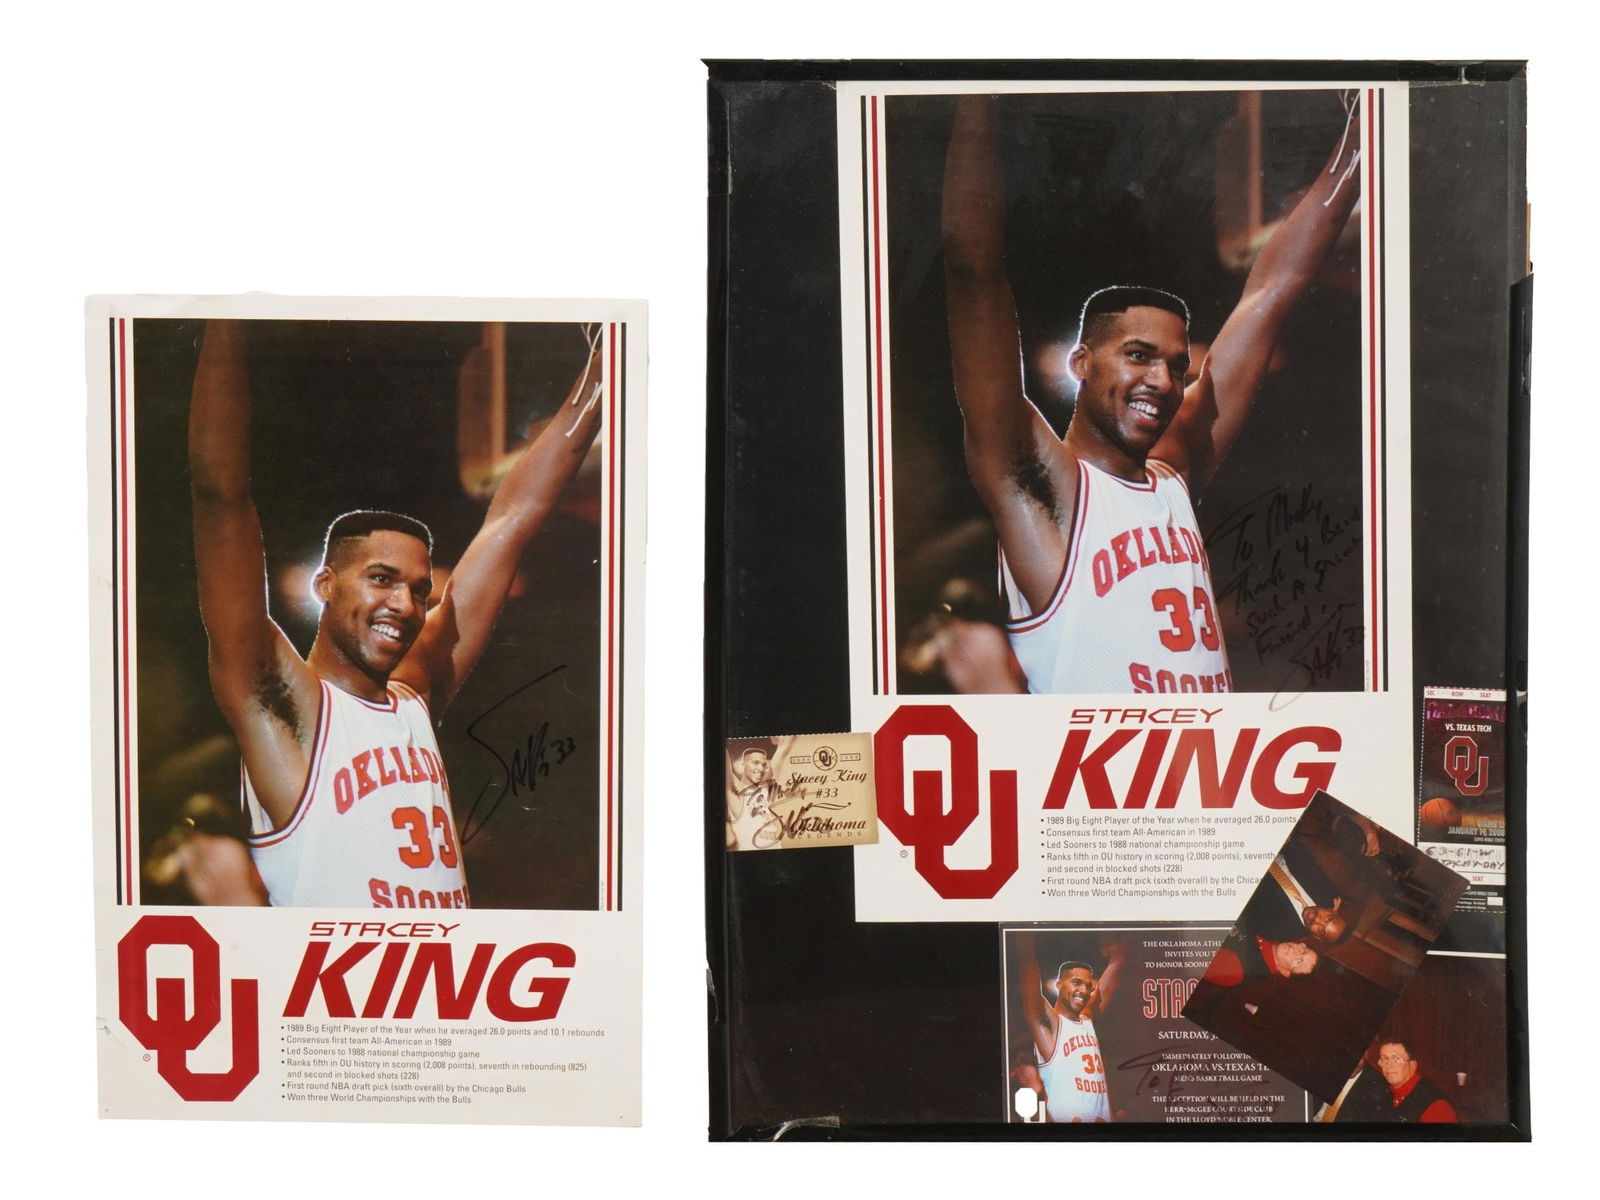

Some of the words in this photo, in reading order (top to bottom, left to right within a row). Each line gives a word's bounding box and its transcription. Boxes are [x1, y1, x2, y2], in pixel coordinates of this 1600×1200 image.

[1151, 586, 1220, 652] 33
[1069, 708, 1223, 724] STACEY
[1456, 724, 1475, 732] TEXAS
[819, 750, 832, 766] OU
[1042, 726, 1342, 810] KING
[1444, 736, 1490, 796] OU
[786, 771, 828, 786] Stacey
[832, 769, 867, 783] King
[816, 787, 839, 798] #33
[874, 705, 1018, 899] OU
[1046, 816, 1064, 825] 1989
[1066, 815, 1080, 826] Big
[1081, 815, 1102, 826] Eight
[1104, 815, 1130, 826] Player
[1131, 815, 1140, 824] of
[1141, 816, 1155, 824] the
[1156, 815, 1174, 824] Year
[1176, 815, 1199, 824] when
[1201, 815, 1212, 824] he
[1213, 815, 1252, 825] averaged
[1254, 814, 1270, 824] 26.0
[1272, 815, 1297, 825] points
[392, 805, 458, 869] 33
[1448, 826, 1478, 835] JANUARY
[310, 922, 461, 938] STACEY
[282, 941, 576, 1022] KING
[118, 915, 260, 1102] OU
[286, 1023, 304, 1032] 1989
[305, 1023, 319, 1034] Big
[320, 1023, 341, 1034] Eight
[342, 1024, 368, 1034] Player
[369, 1024, 378, 1033] of
[394, 1025, 412, 1033] Year
[413, 1025, 436, 1034] when
[450, 1027, 487, 1036] averaged
[489, 1026, 506, 1035] 26.0
[506, 1028, 531, 1036] points
[532, 1028, 548, 1036] and
[550, 1027, 564, 1036] 10.1
[1158, 1031, 1209, 1040] SATURDAY,
[286, 1035, 330, 1044] Consensus
[331, 1035, 347, 1044] first
[370, 1036, 422, 1045] All-American
[434, 1037, 452, 1046] 1989
[286, 1046, 300, 1055] Led
[302, 1046, 336, 1055] Sooners
[348, 1047, 365, 1056] 1988
[400, 1049, 456, 1058] championship
[457, 1051, 480, 1060] game
[286, 1058, 311, 1066] Ranks
[312, 1058, 328, 1066] fifth
[330, 1058, 338, 1067] in
[339, 1058, 352, 1067] OU
[353, 1059, 380, 1069] history
[391, 1061, 421, 1070] scoring
[422, 1060, 446, 1069] (2,008
[447, 1061, 476, 1070] points),
[511, 1061, 519, 1069] in
[521, 1062, 566, 1072] rebounding
[567, 1062, 587, 1071] (825)
[1082, 1053, 1104, 1074] 33
[1152, 1063, 1209, 1072] OKLAHOMA
[1211, 1063, 1224, 1071] VS.
[1225, 1063, 1256, 1071] TEXAS
[286, 1069, 302, 1078] and
[303, 1070, 332, 1078] second
[344, 1070, 375, 1079] blocked
[376, 1071, 398, 1079] shots
[400, 1071, 419, 1080] (228)
[286, 1080, 304, 1089] First
[306, 1082, 329, 1090] round
[331, 1081, 350, 1090] NBA
[351, 1082, 370, 1090] draft
[372, 1082, 389, 1092] pick
[390, 1082, 412, 1091] (sixth
[414, 1083, 444, 1092] overall)
[445, 1084, 455, 1093] by
[471, 1084, 504, 1094] Chicago
[506, 1084, 526, 1093] Bulls
[286, 1092, 306, 1101] Won
[307, 1092, 328, 1101] three
[329, 1093, 354, 1102] World
[355, 1093, 416, 1103] Championships
[417, 1094, 435, 1102] with
[451, 1095, 472, 1104] Bulls
